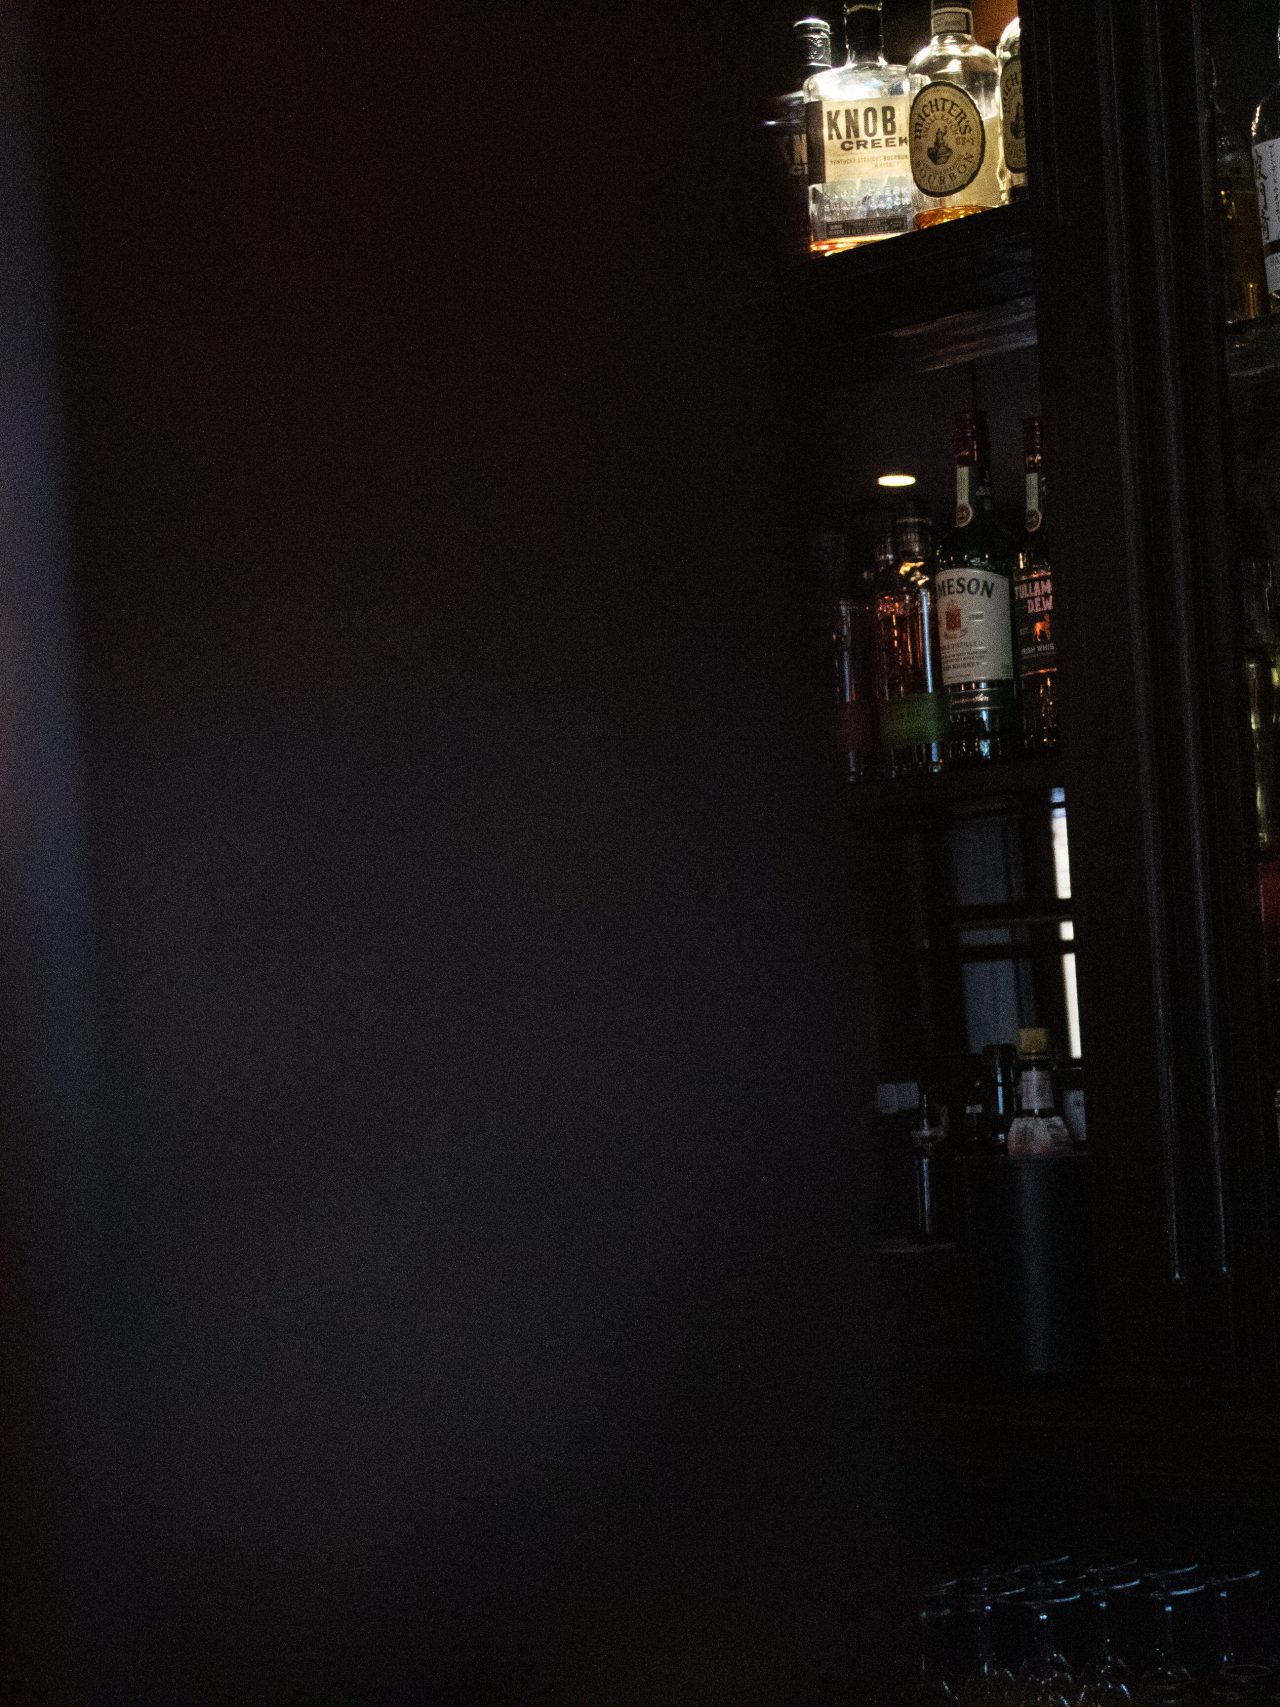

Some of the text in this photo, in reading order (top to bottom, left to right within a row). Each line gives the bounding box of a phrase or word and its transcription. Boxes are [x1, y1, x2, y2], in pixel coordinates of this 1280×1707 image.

[826, 106, 897, 140] KNOB
[914, 97, 973, 140] MICHTER'S
[937, 577, 995, 599] MESON
[1014, 579, 1053, 601] TULLAM
